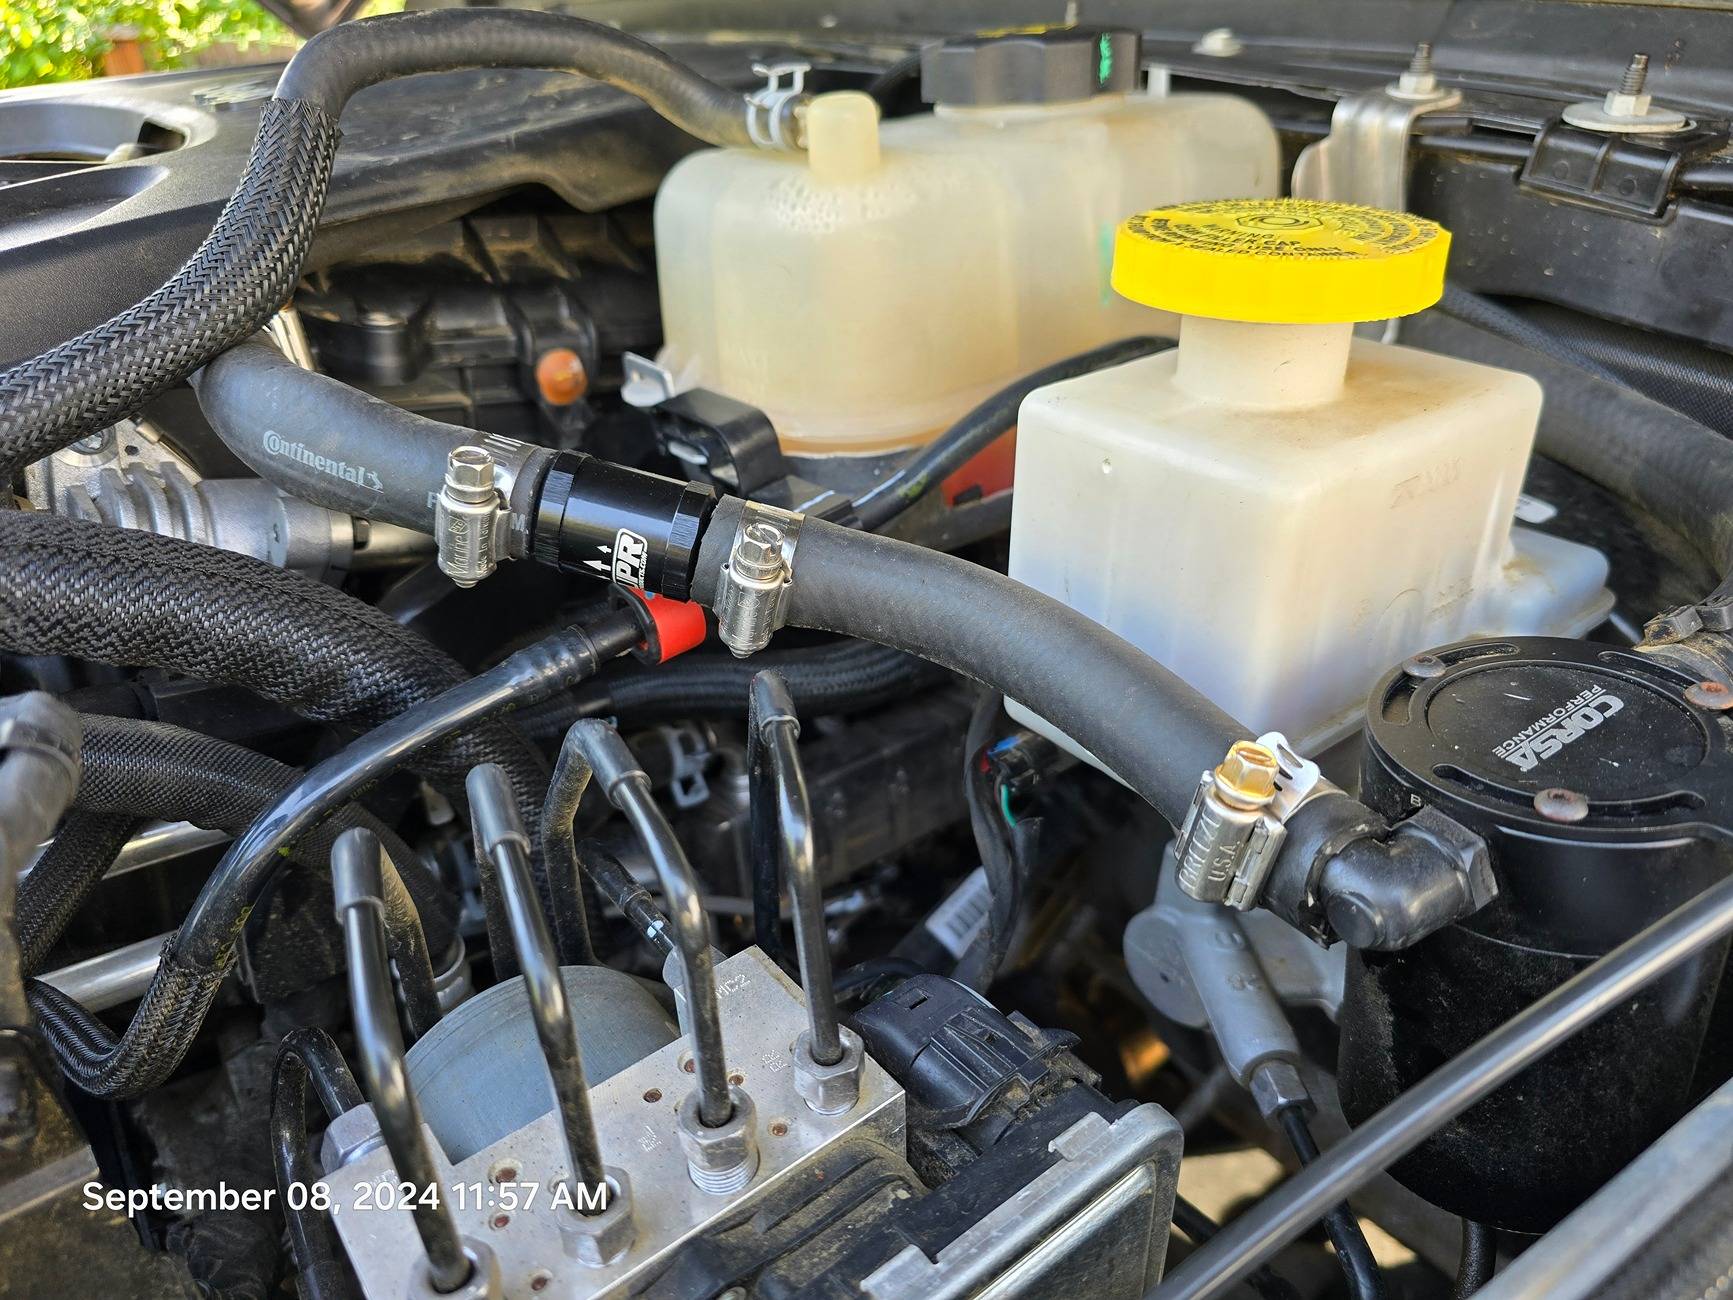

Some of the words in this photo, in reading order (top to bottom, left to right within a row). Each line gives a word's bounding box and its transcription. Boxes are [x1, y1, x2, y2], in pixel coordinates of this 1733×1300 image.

[263, 429, 367, 488] Continental
[1491, 684, 1602, 758] PERFORMANCE
[1505, 694, 1625, 772] CORSA
[1207, 841, 1240, 882] U.S.A.
